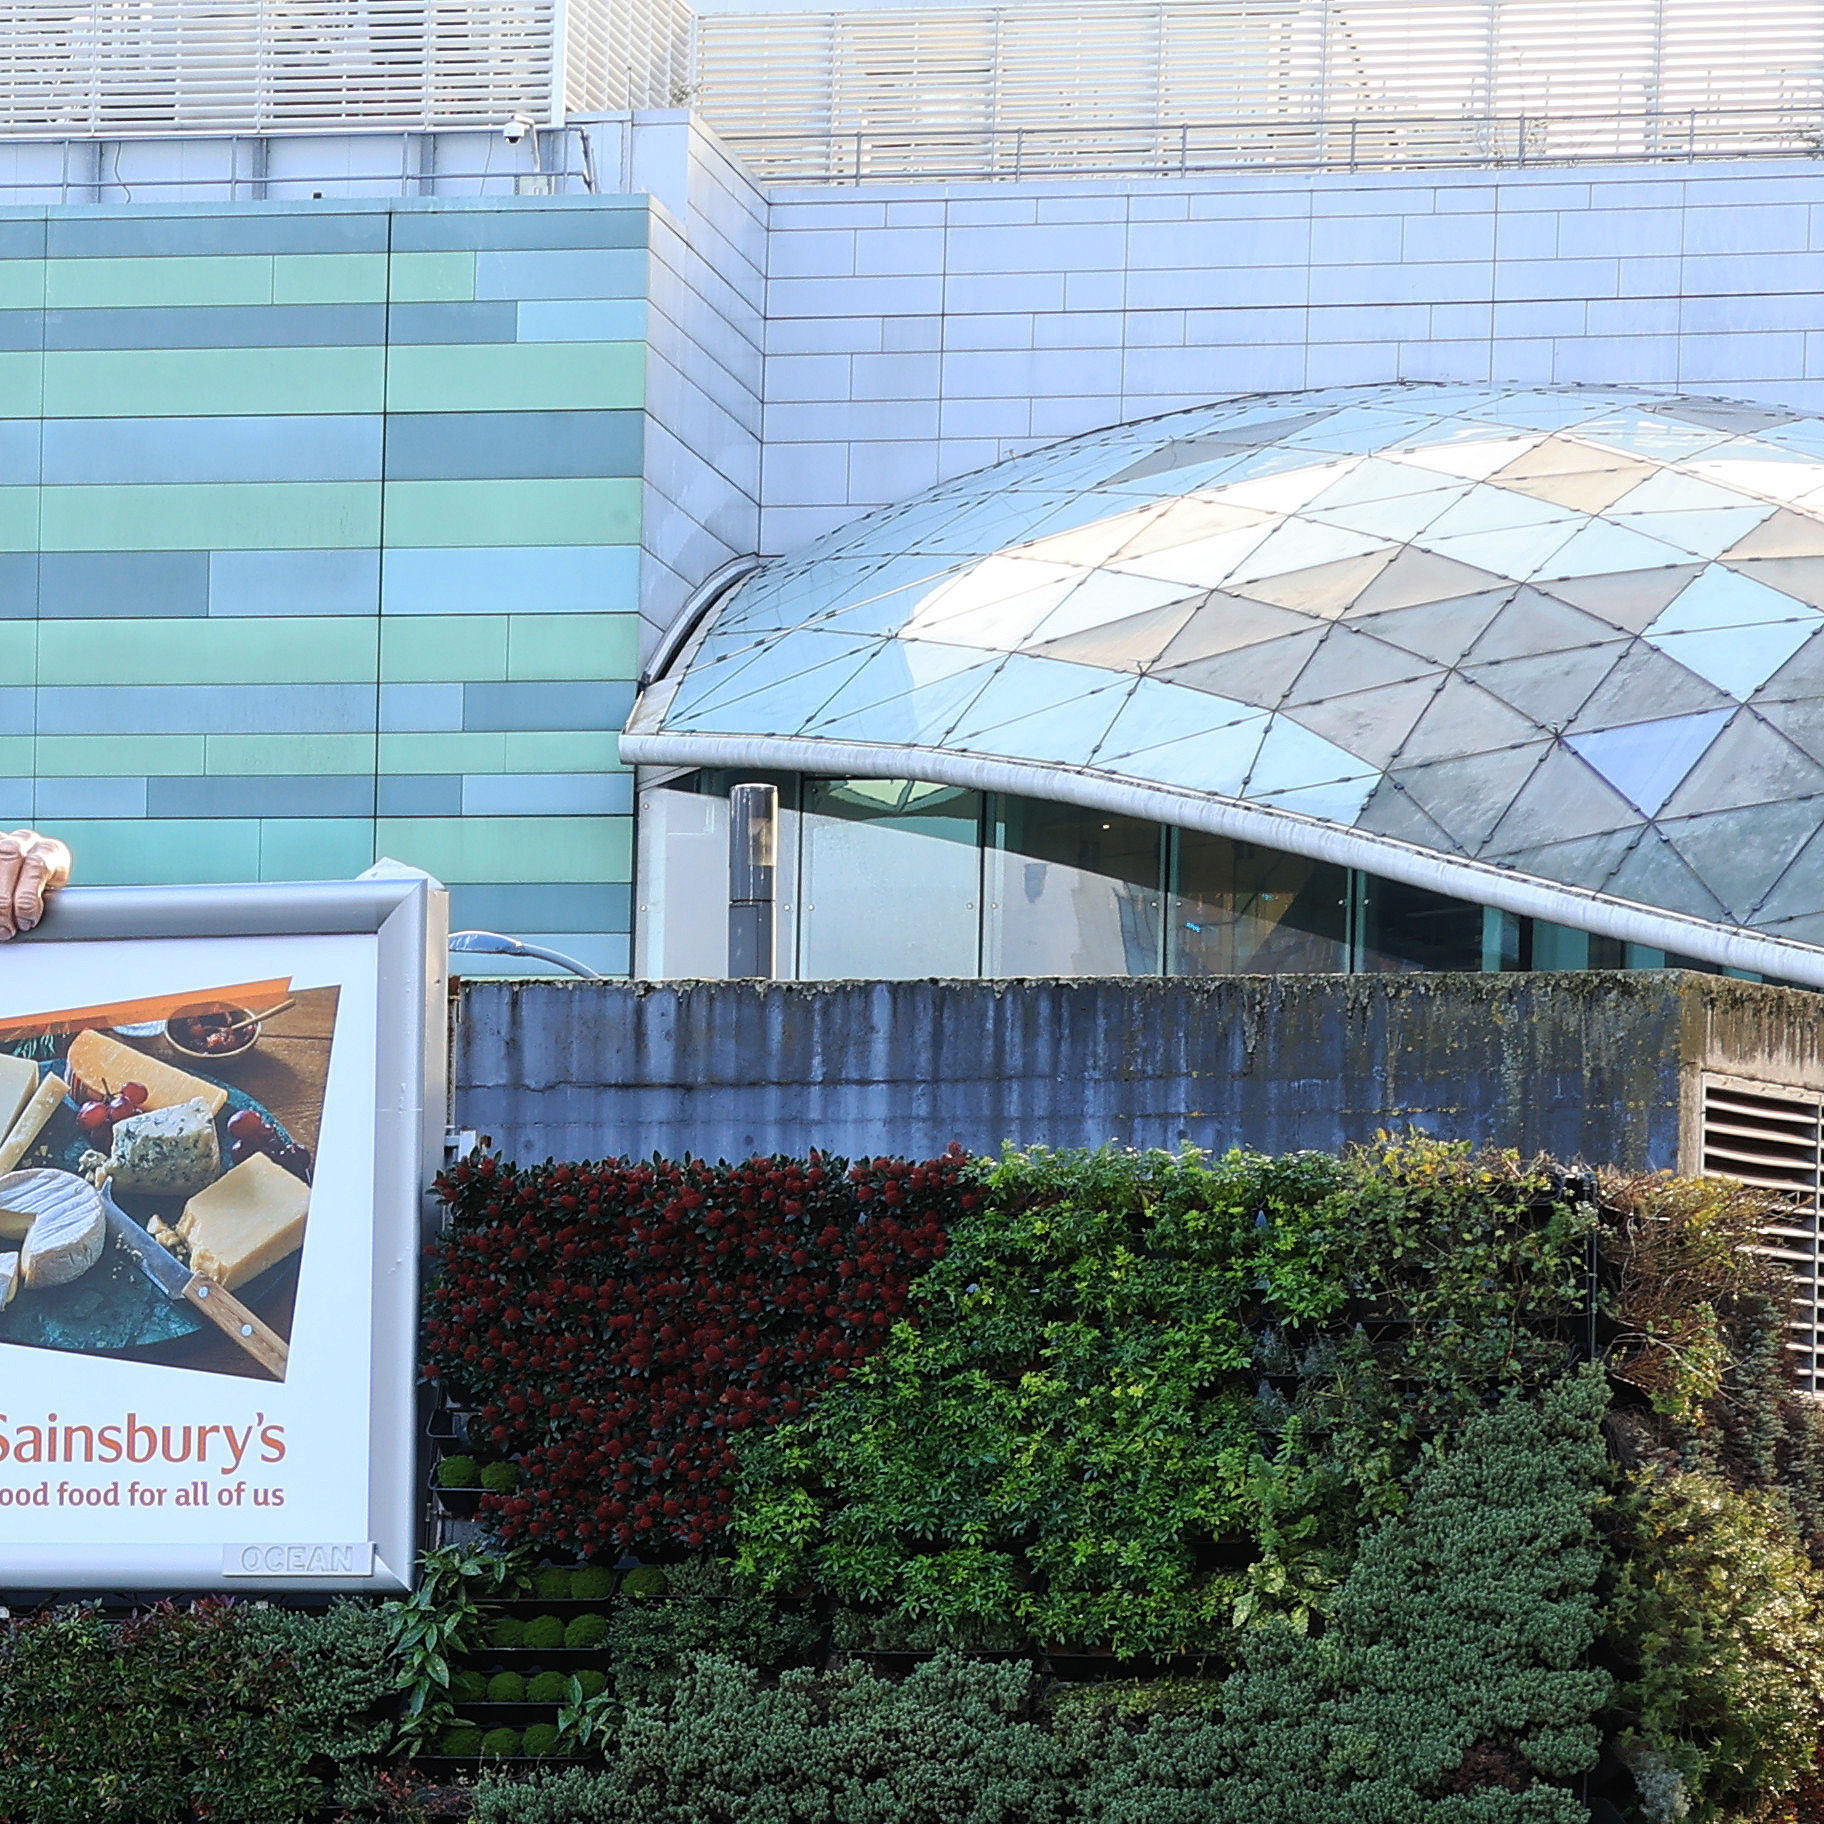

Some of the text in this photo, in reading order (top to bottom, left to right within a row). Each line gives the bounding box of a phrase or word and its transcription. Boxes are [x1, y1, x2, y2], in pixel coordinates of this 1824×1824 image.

[57, 1480, 120, 1507] food
[128, 1480, 167, 1507] for
[175, 1480, 209, 1507] all
[218, 1480, 248, 1507] of
[253, 1488, 284, 1507] us
[241, 1546, 352, 1572] OCEAN
